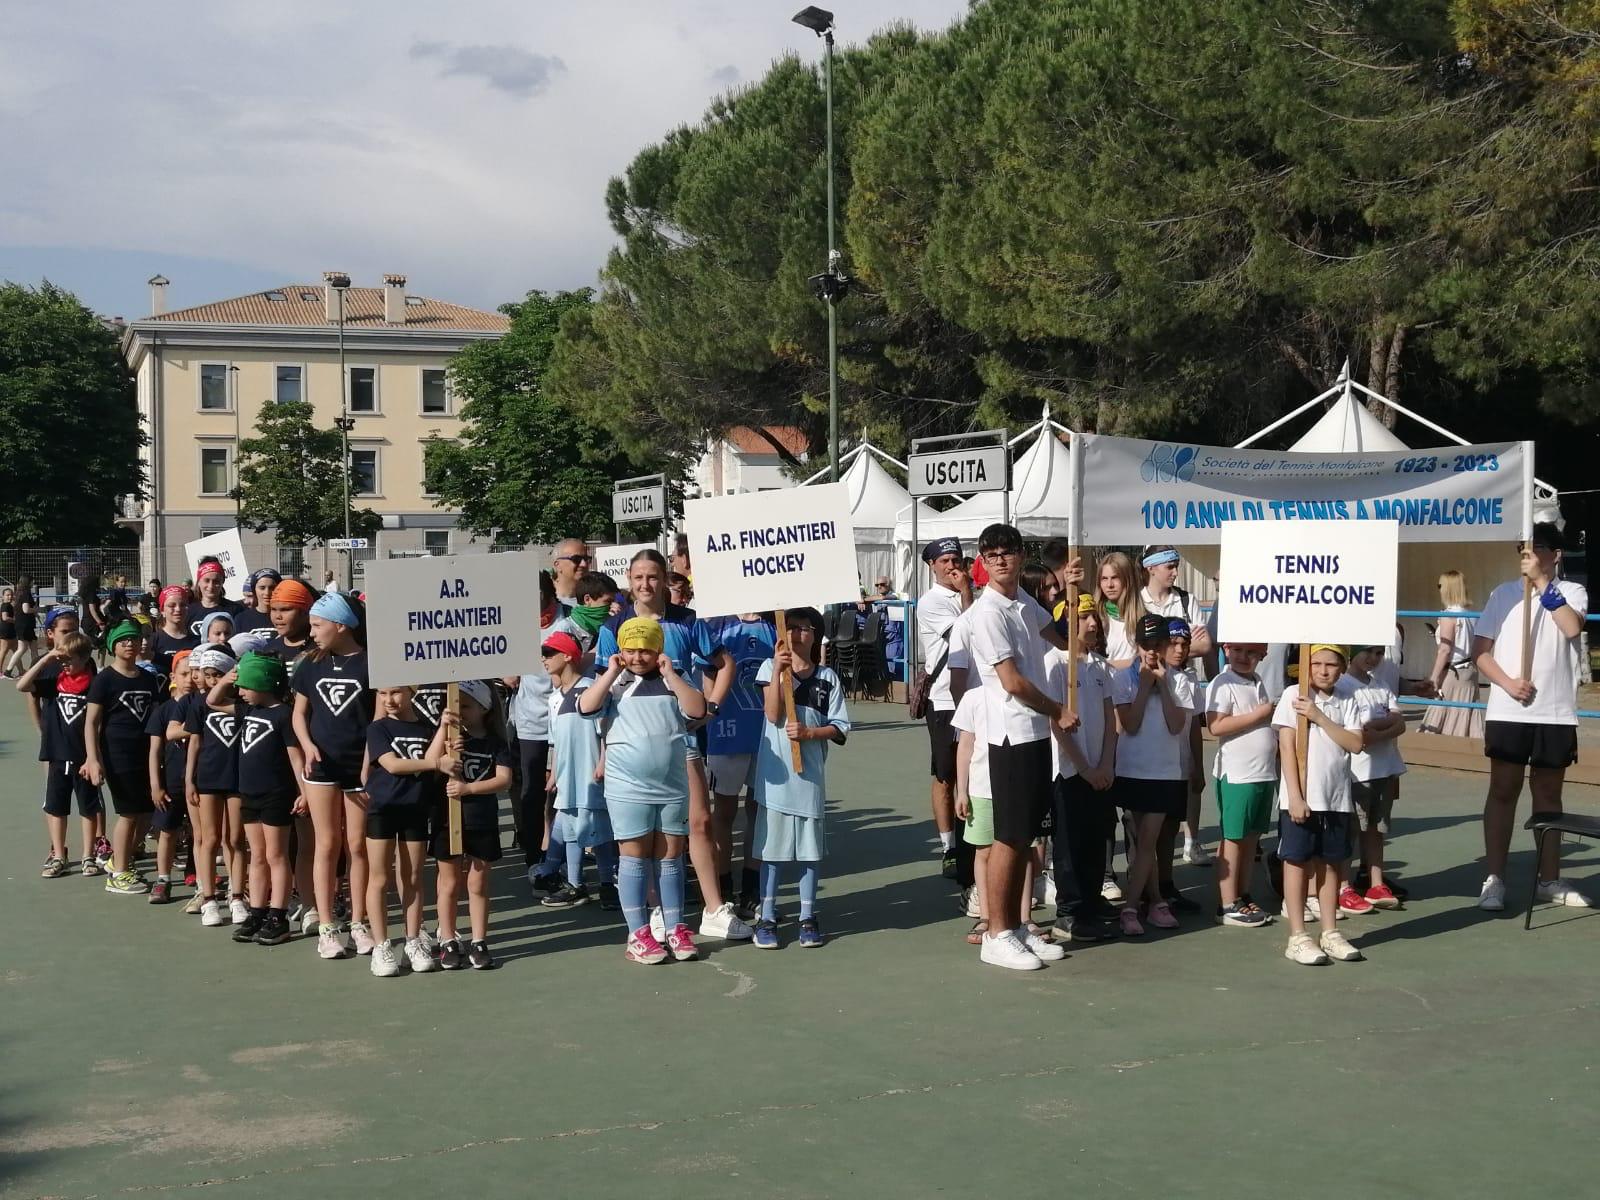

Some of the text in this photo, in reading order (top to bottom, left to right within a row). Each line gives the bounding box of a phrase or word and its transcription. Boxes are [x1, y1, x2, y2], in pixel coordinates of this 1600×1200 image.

[925, 458, 987, 486] USCITA
[1202, 457, 1250, 470] Società
[1253, 458, 1277, 470] del
[1278, 459, 1314, 470] Tennis
[1317, 459, 1385, 471] Monfalcone
[1394, 456, 1438, 473] 1923
[1453, 454, 1500, 472] 2023
[621, 494, 654, 514] USCITA
[1141, 500, 1178, 529] 100
[1185, 501, 1236, 529] ANNI
[1242, 501, 1264, 521] DI
[1269, 500, 1349, 521] TENNIS
[1373, 498, 1504, 526] MONFALCONE
[706, 521, 836, 553] A.R. FINCANTIERI
[603, 557, 628, 567] ARCO
[742, 553, 805, 578] HOCKEY
[1274, 555, 1339, 574] TENNIS
[439, 578, 469, 599] A.R.
[1239, 585, 1375, 605] MONFALCONE
[408, 606, 502, 631] FINCANTIERI
[404, 635, 508, 661] PATTINAGGIO
[716, 719, 737, 738] 15
